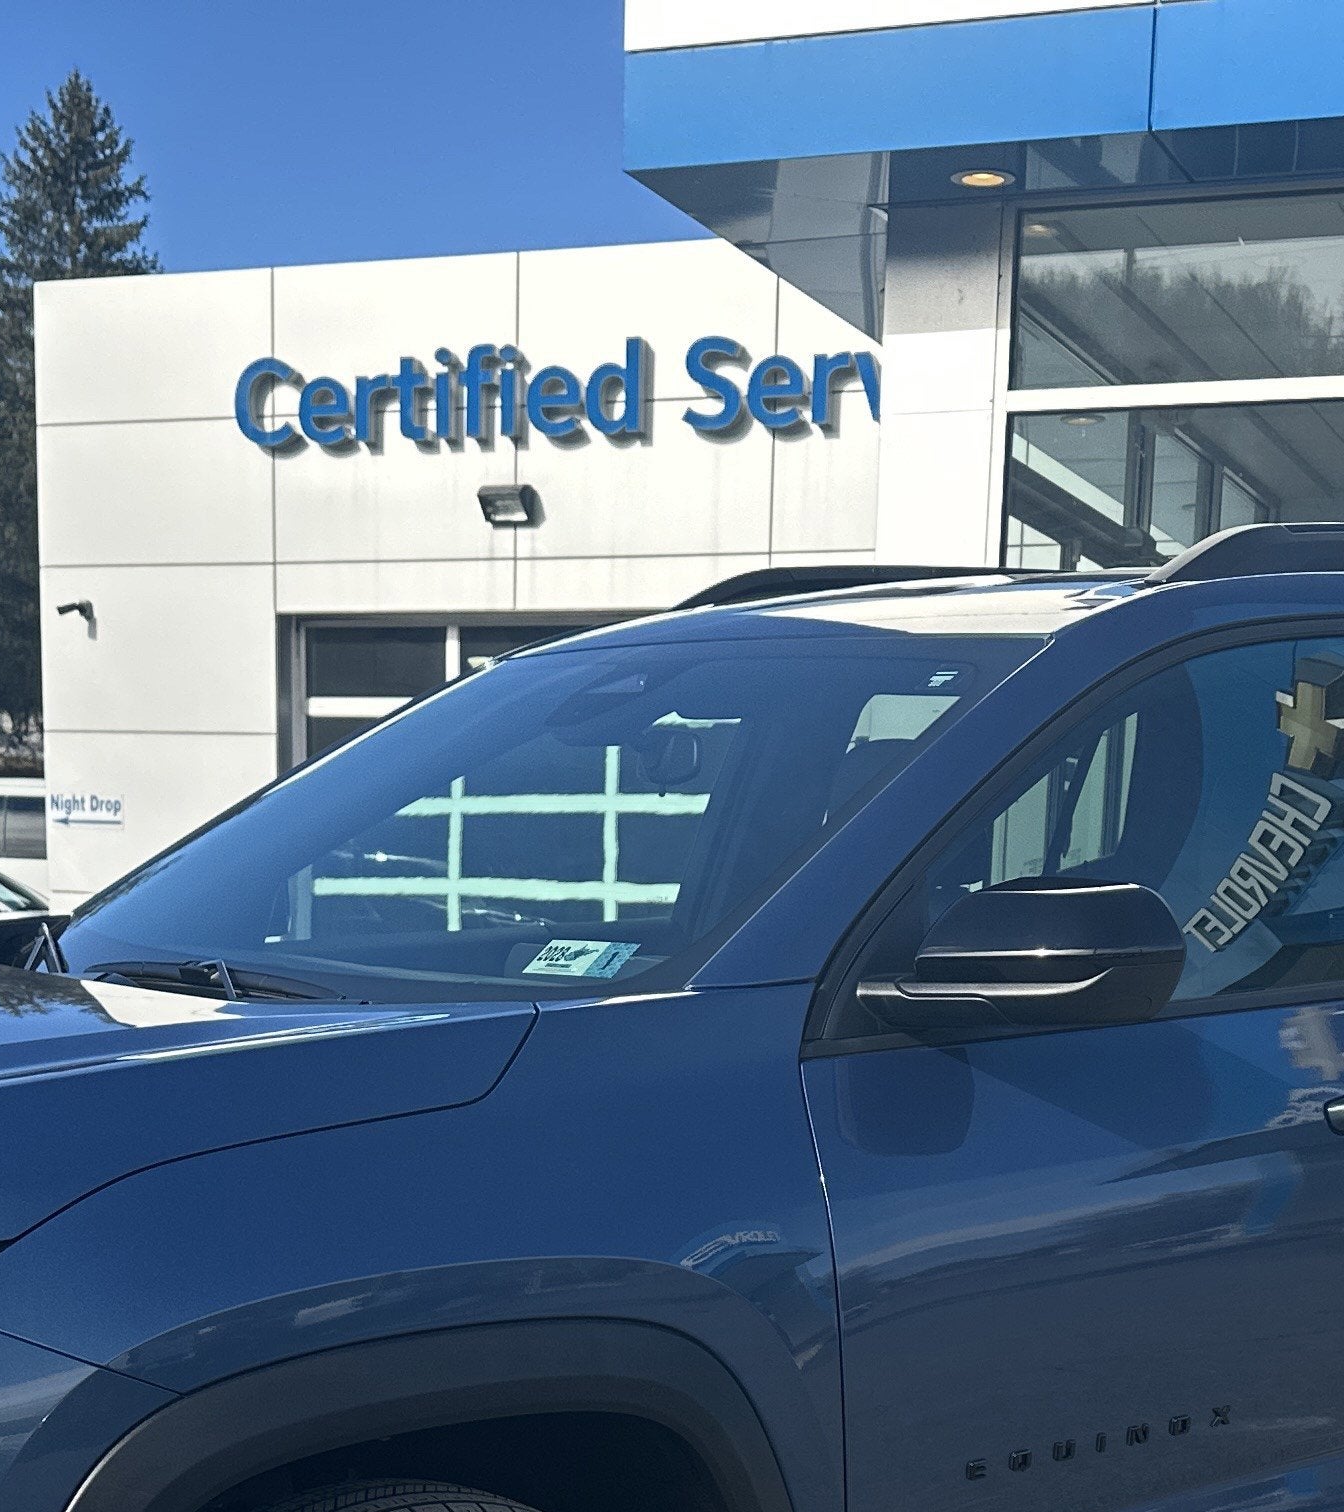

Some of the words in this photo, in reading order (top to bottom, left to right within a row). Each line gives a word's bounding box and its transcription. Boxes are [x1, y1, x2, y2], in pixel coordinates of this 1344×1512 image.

[235, 336, 651, 449] Certified
[50, 793, 86, 815] Night
[90, 794, 121, 817] Drop
[965, 1404, 1231, 1481] EQUINOX
